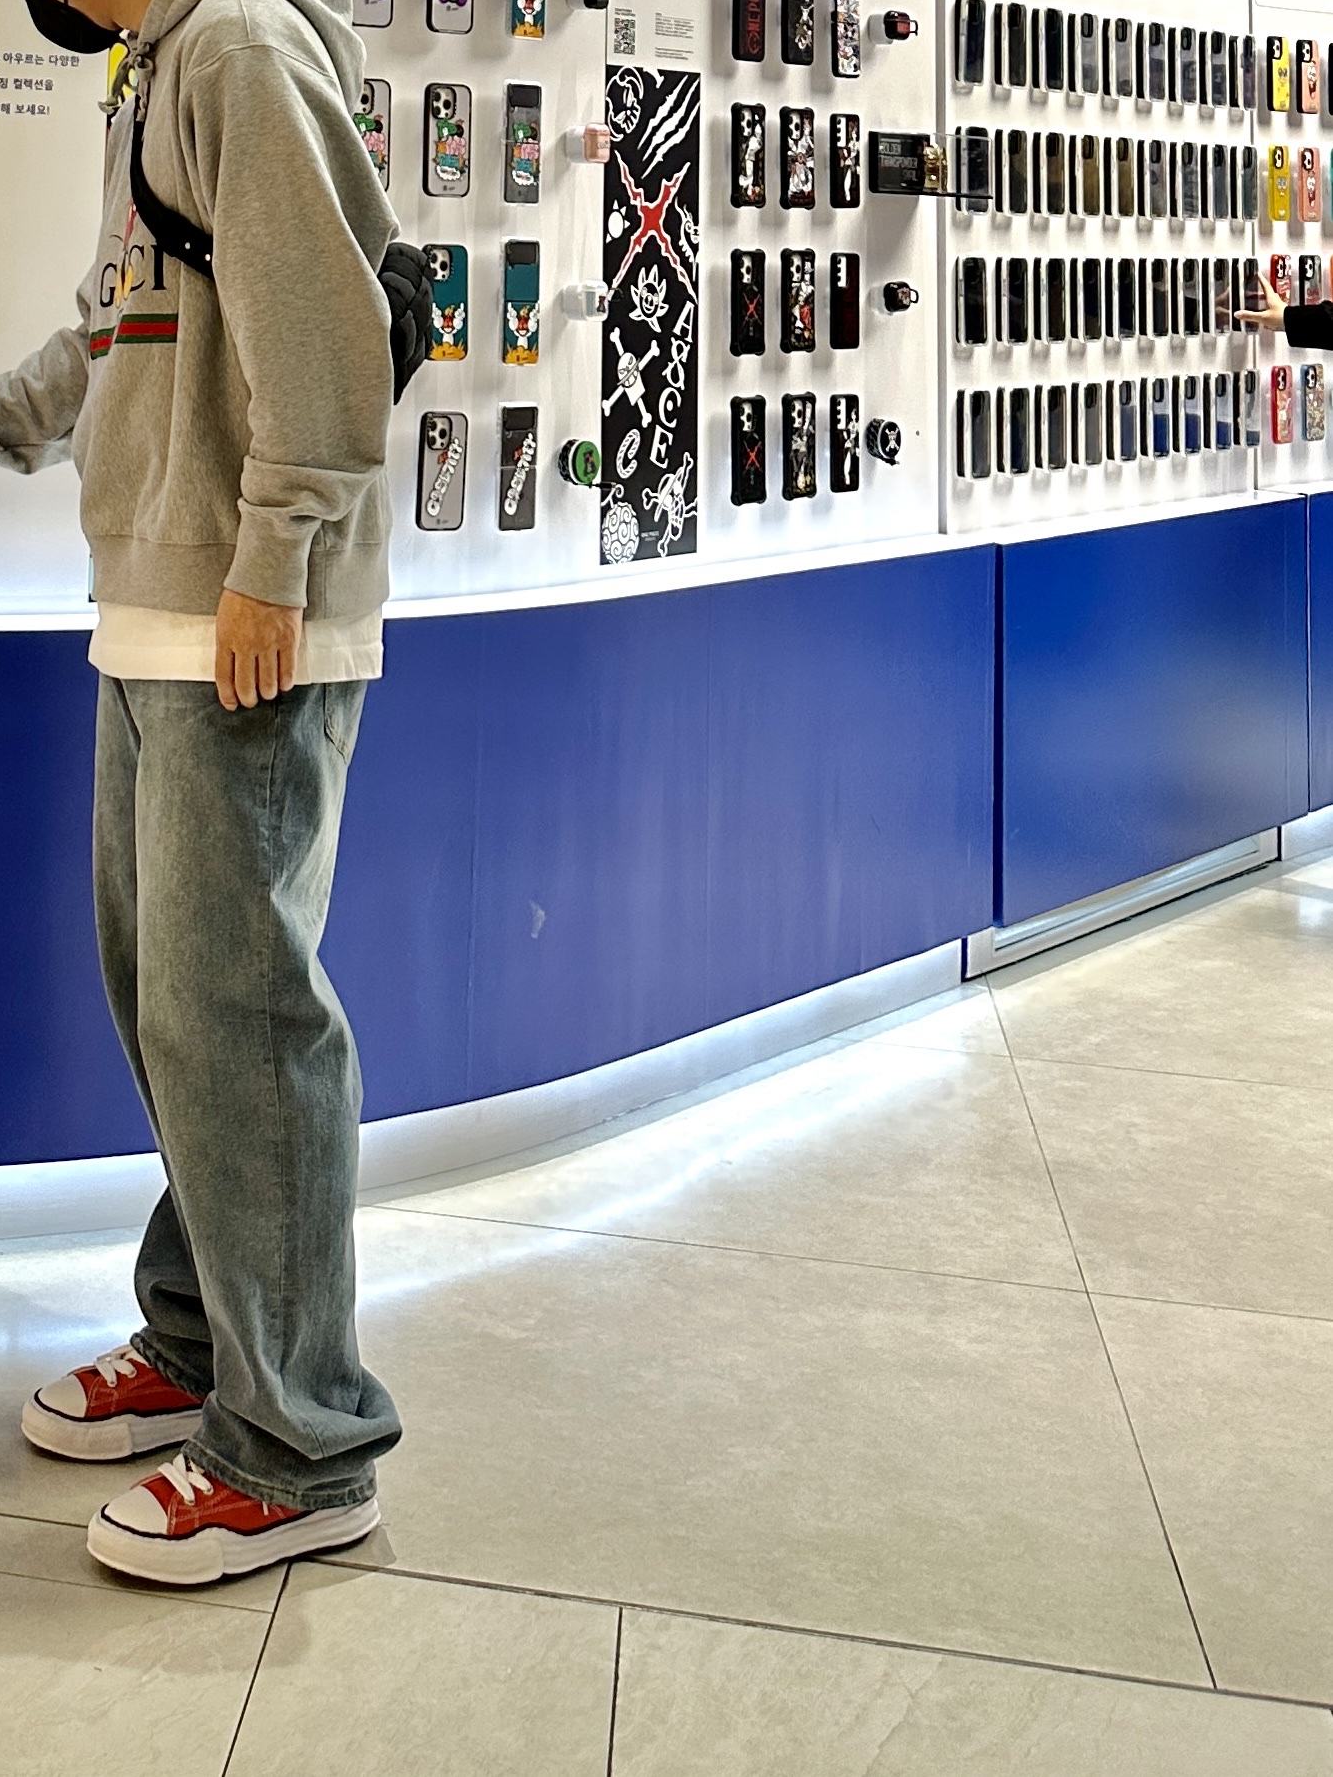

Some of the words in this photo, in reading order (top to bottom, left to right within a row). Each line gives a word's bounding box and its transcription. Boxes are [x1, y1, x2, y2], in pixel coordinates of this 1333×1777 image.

[3, 52, 45, 66] 아우르는
[48, 54, 80, 67] 다양한
[13, 78, 54, 91] 컬렉션을
[14, 104, 50, 116] 보세요!
